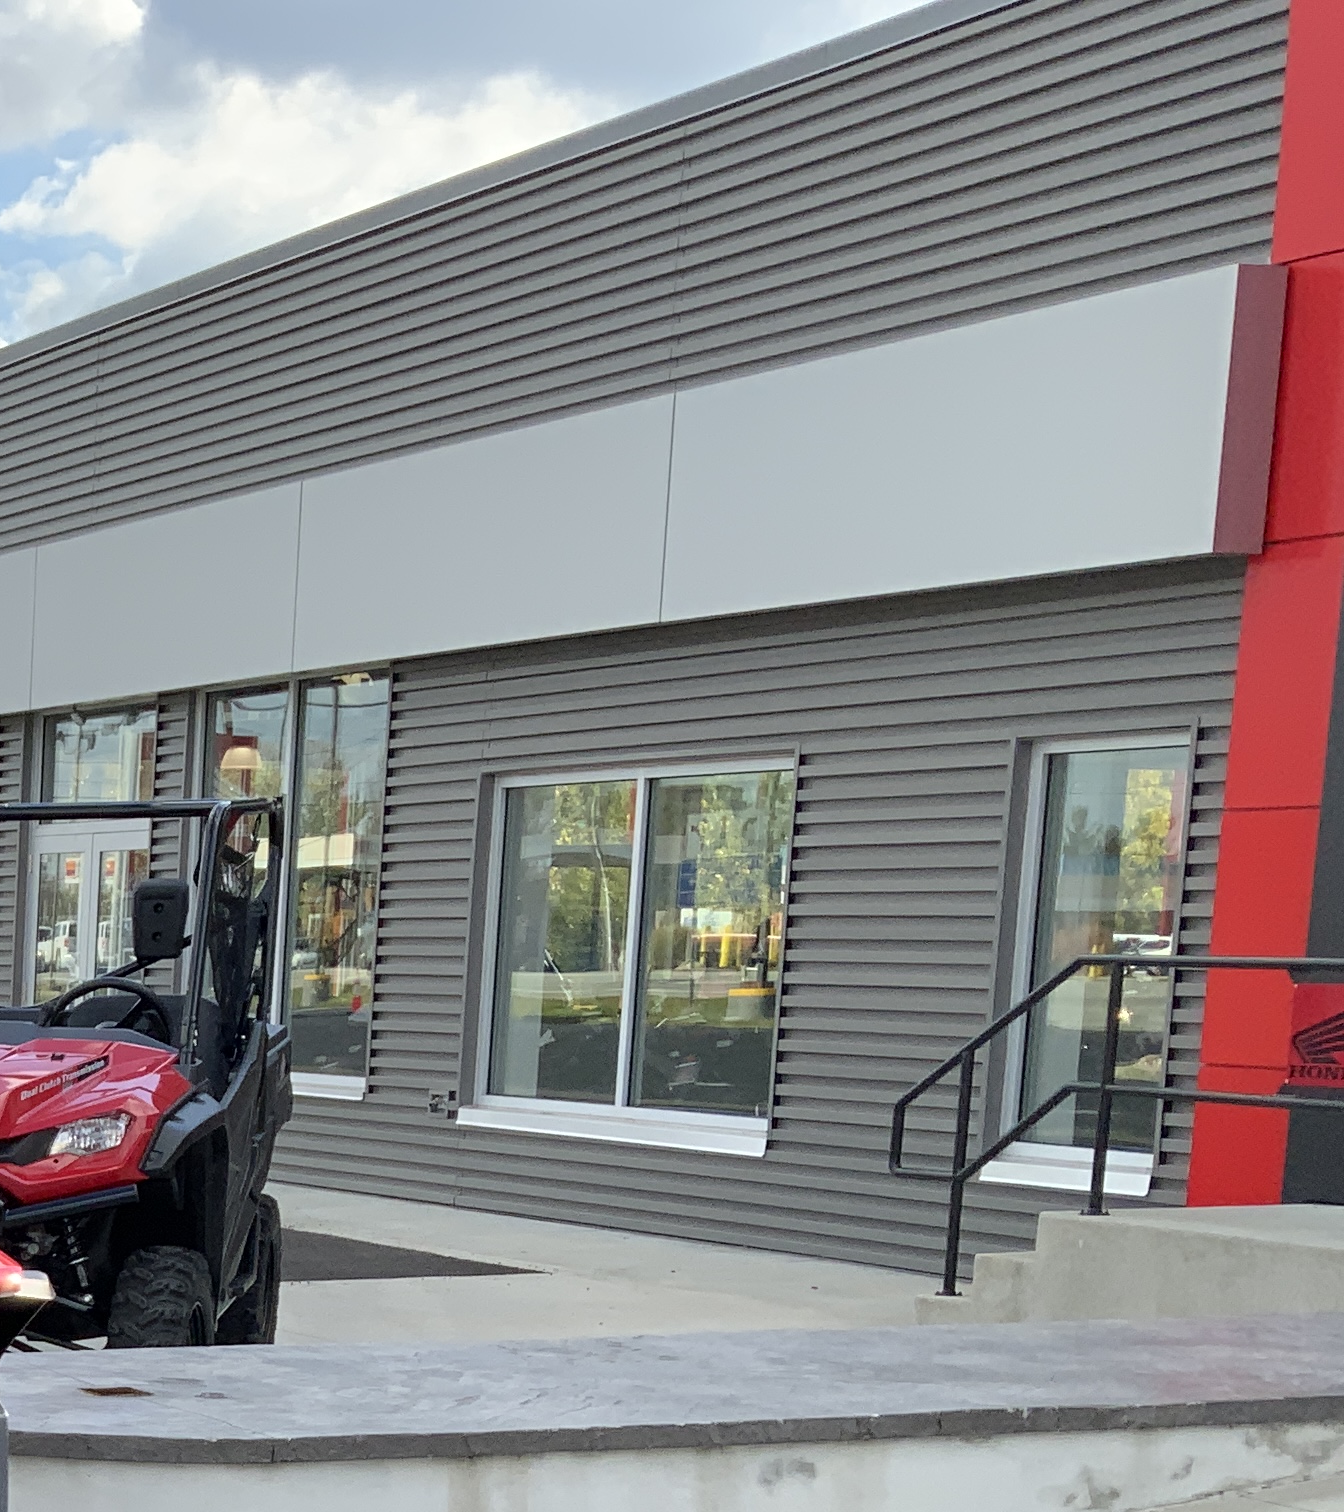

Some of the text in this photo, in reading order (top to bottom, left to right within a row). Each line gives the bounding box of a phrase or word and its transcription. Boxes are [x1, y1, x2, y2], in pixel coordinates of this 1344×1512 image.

[20, 1084, 38, 1101] Dual
[39, 1073, 63, 1095] Clutch
[62, 1060, 105, 1083] Transmission
[1289, 1064, 1344, 1081] HON
